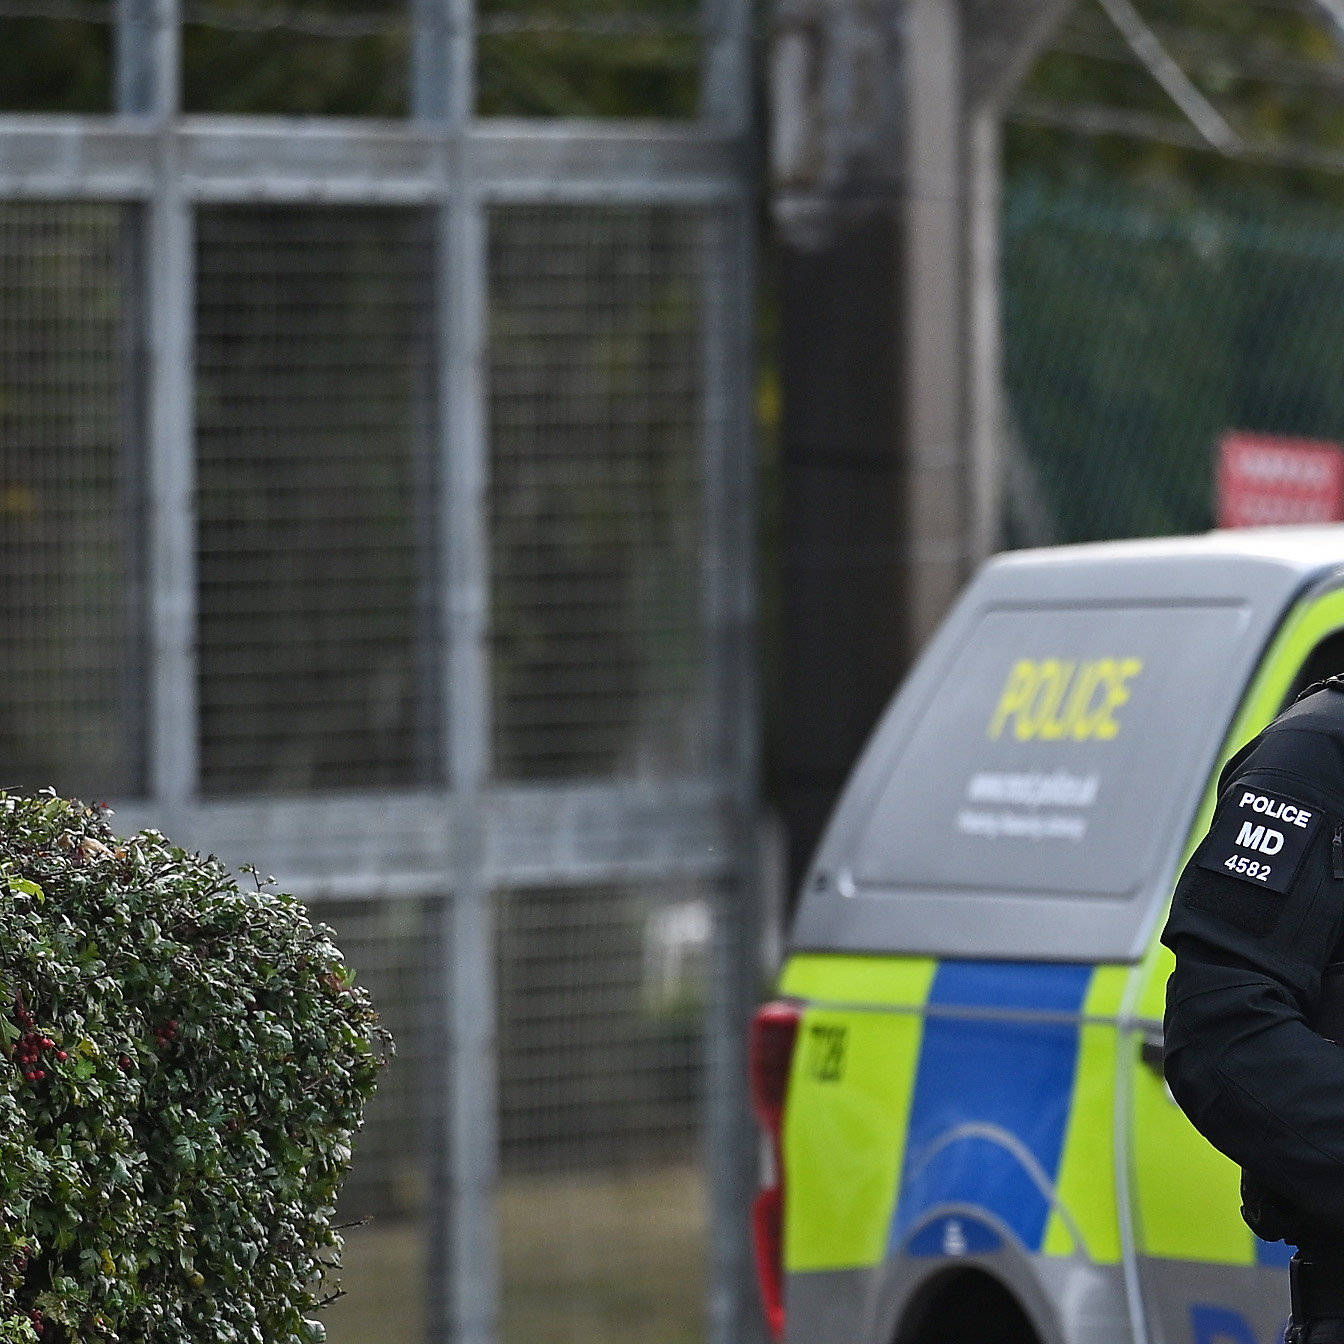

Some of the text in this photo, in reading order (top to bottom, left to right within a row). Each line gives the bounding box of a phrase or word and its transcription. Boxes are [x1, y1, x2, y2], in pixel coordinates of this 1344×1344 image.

[987, 656, 1145, 741] POLICE
[1238, 791, 1313, 829] POLICE
[1234, 820, 1285, 856] MD
[1223, 854, 1272, 882] 4582
